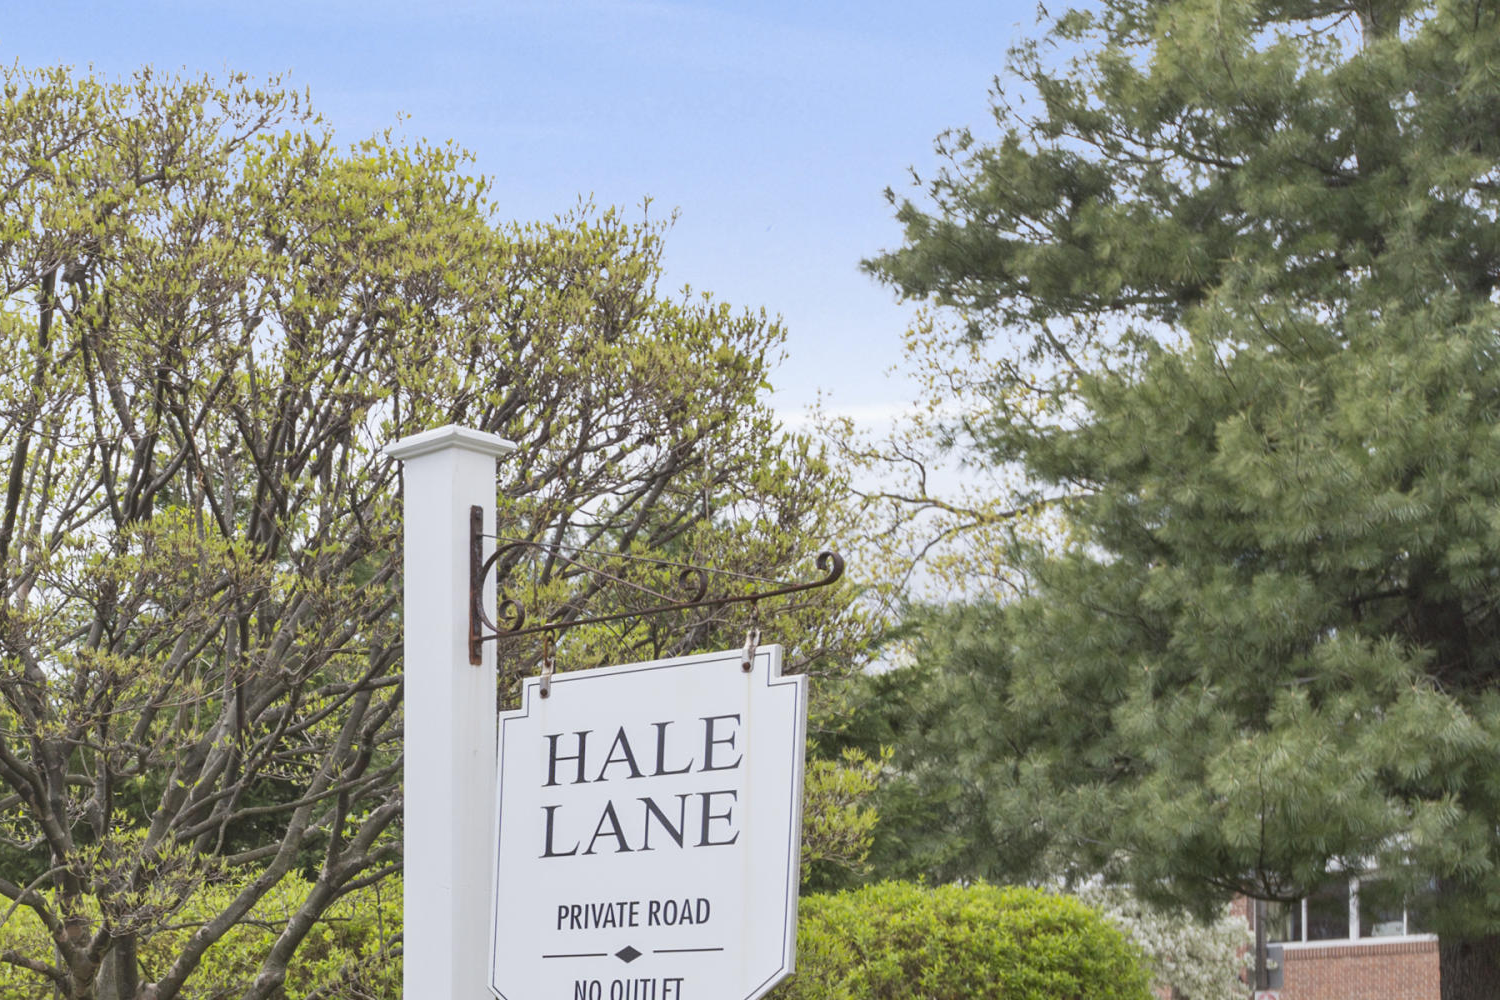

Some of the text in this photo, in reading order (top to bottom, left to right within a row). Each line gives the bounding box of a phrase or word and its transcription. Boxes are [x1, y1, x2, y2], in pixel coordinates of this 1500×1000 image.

[541, 713, 743, 788] HALE
[538, 789, 740, 859] LANE
[556, 897, 711, 931] PRIVATE ROAD
